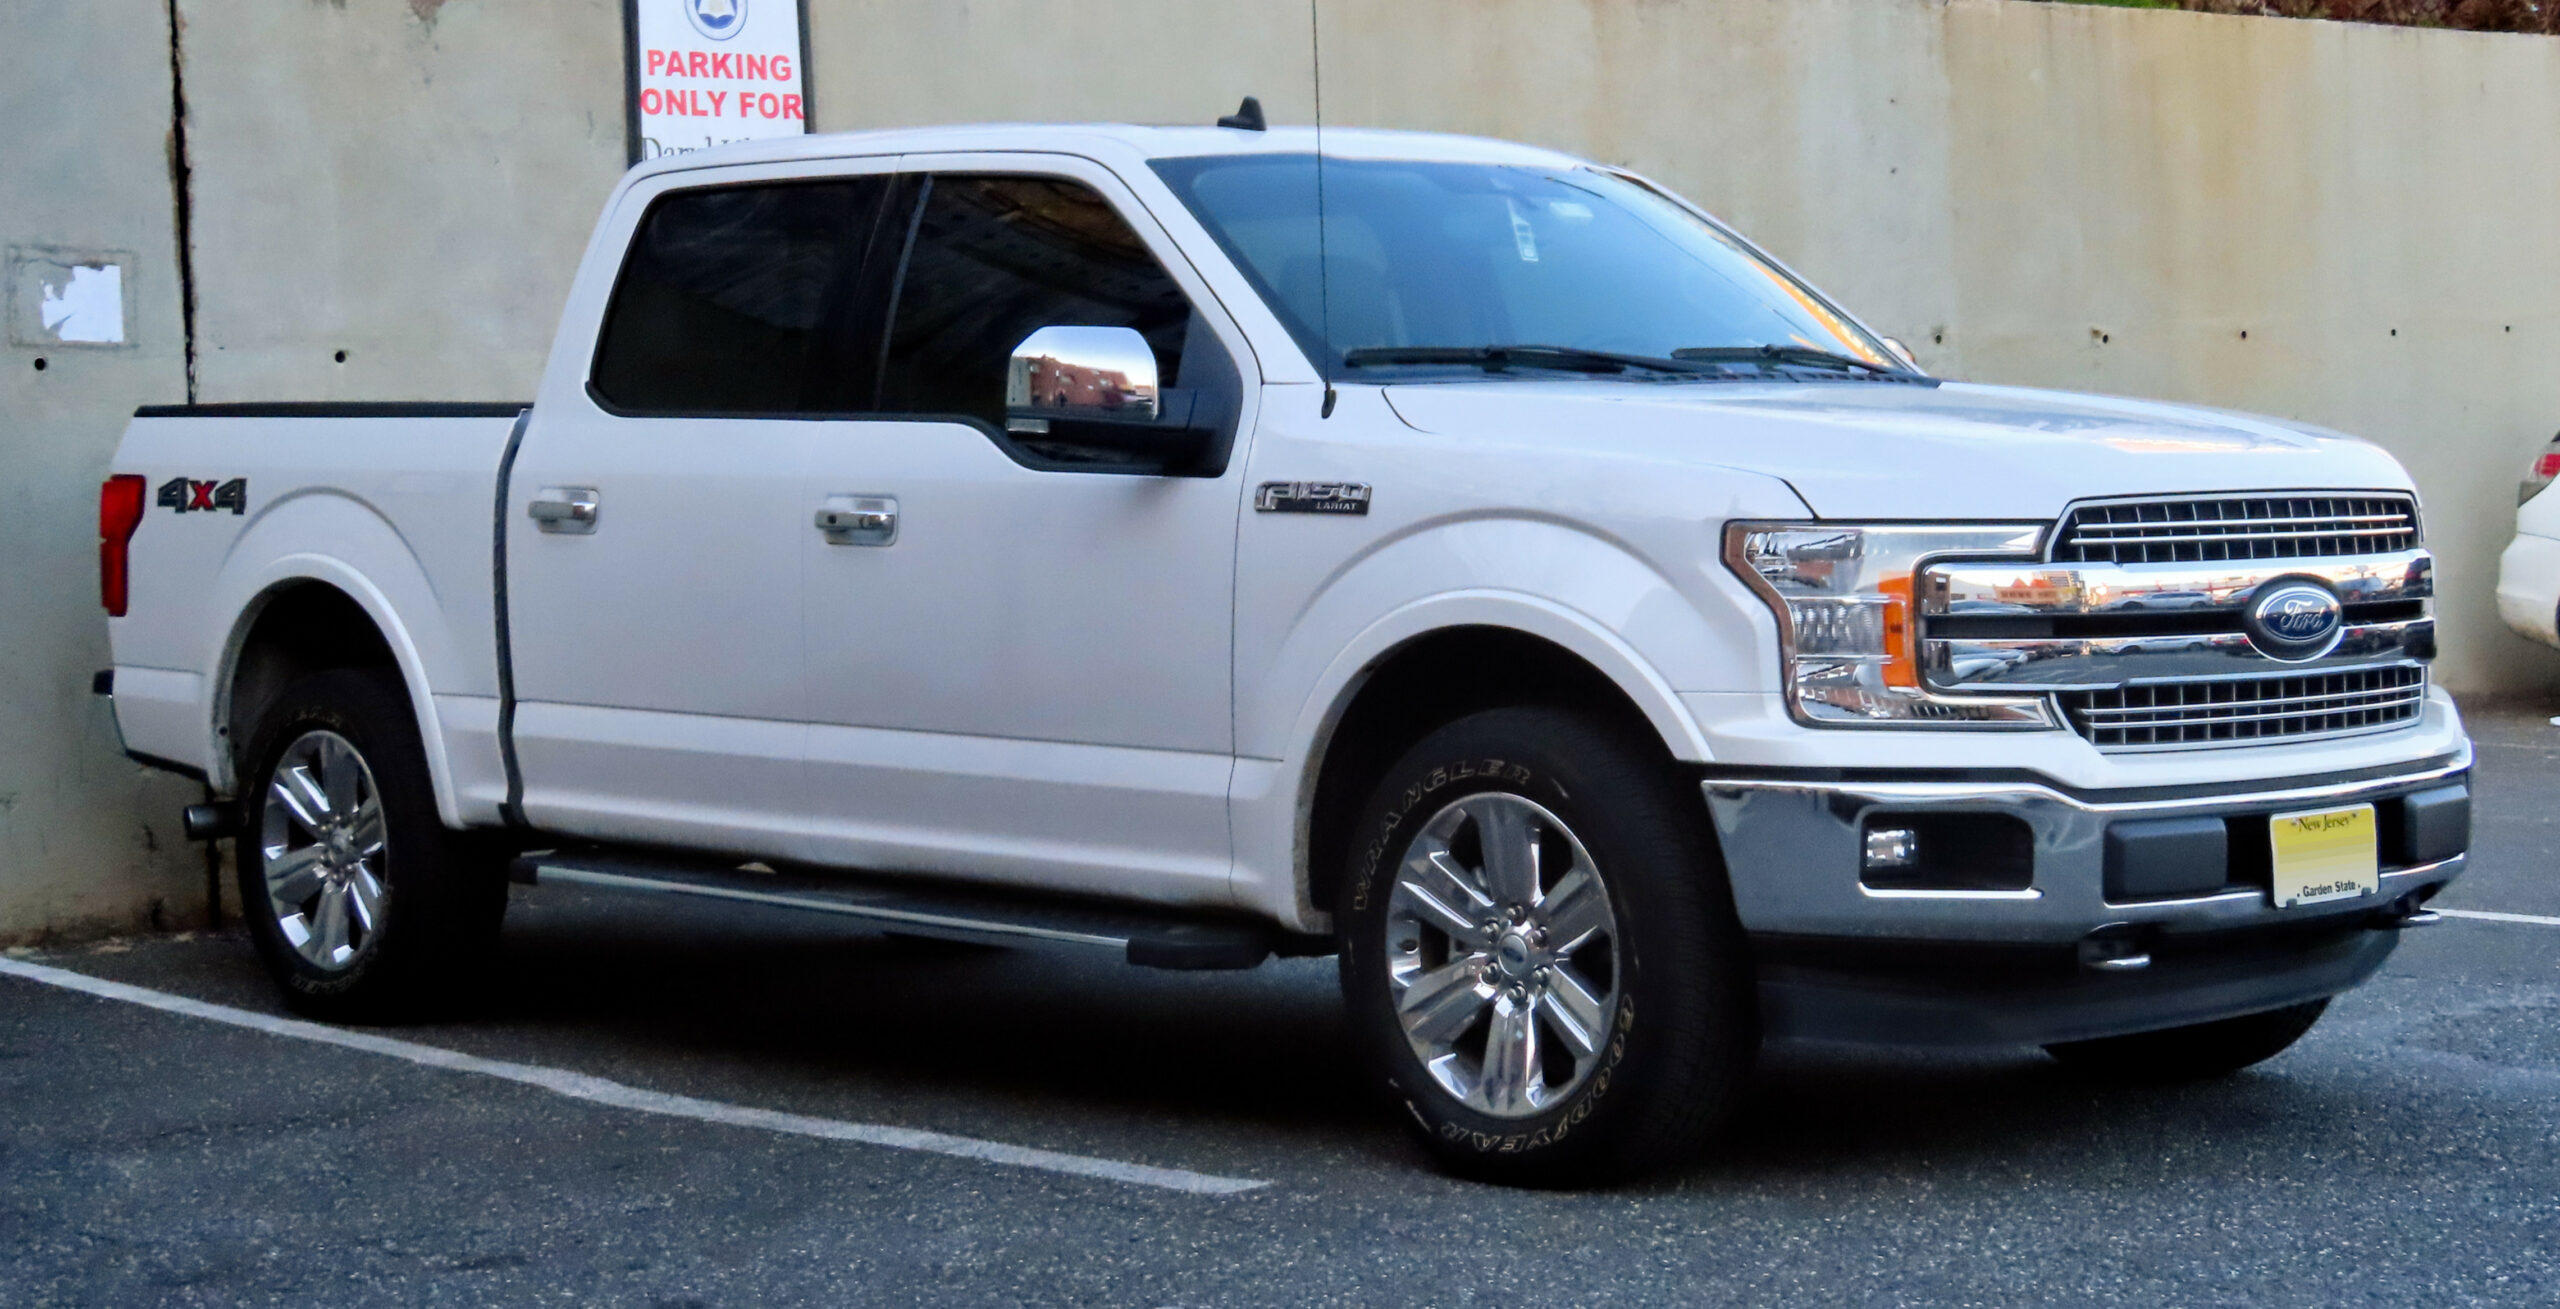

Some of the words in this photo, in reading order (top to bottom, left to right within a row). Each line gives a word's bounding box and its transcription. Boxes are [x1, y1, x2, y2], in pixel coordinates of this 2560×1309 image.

[646, 49, 792, 82] PARKING
[640, 87, 728, 118] ONLY
[739, 92, 805, 120] FOR
[1315, 500, 1357, 511] LARIAT
[2280, 599, 2324, 630] Ford
[1352, 758, 1531, 911] WRANGLER
[2298, 818, 2321, 832] New
[2322, 814, 2350, 832] Jersey
[2302, 884, 2332, 897] Garden
[2335, 880, 2356, 893] State
[1440, 993, 1634, 1153] GOODYEAR
